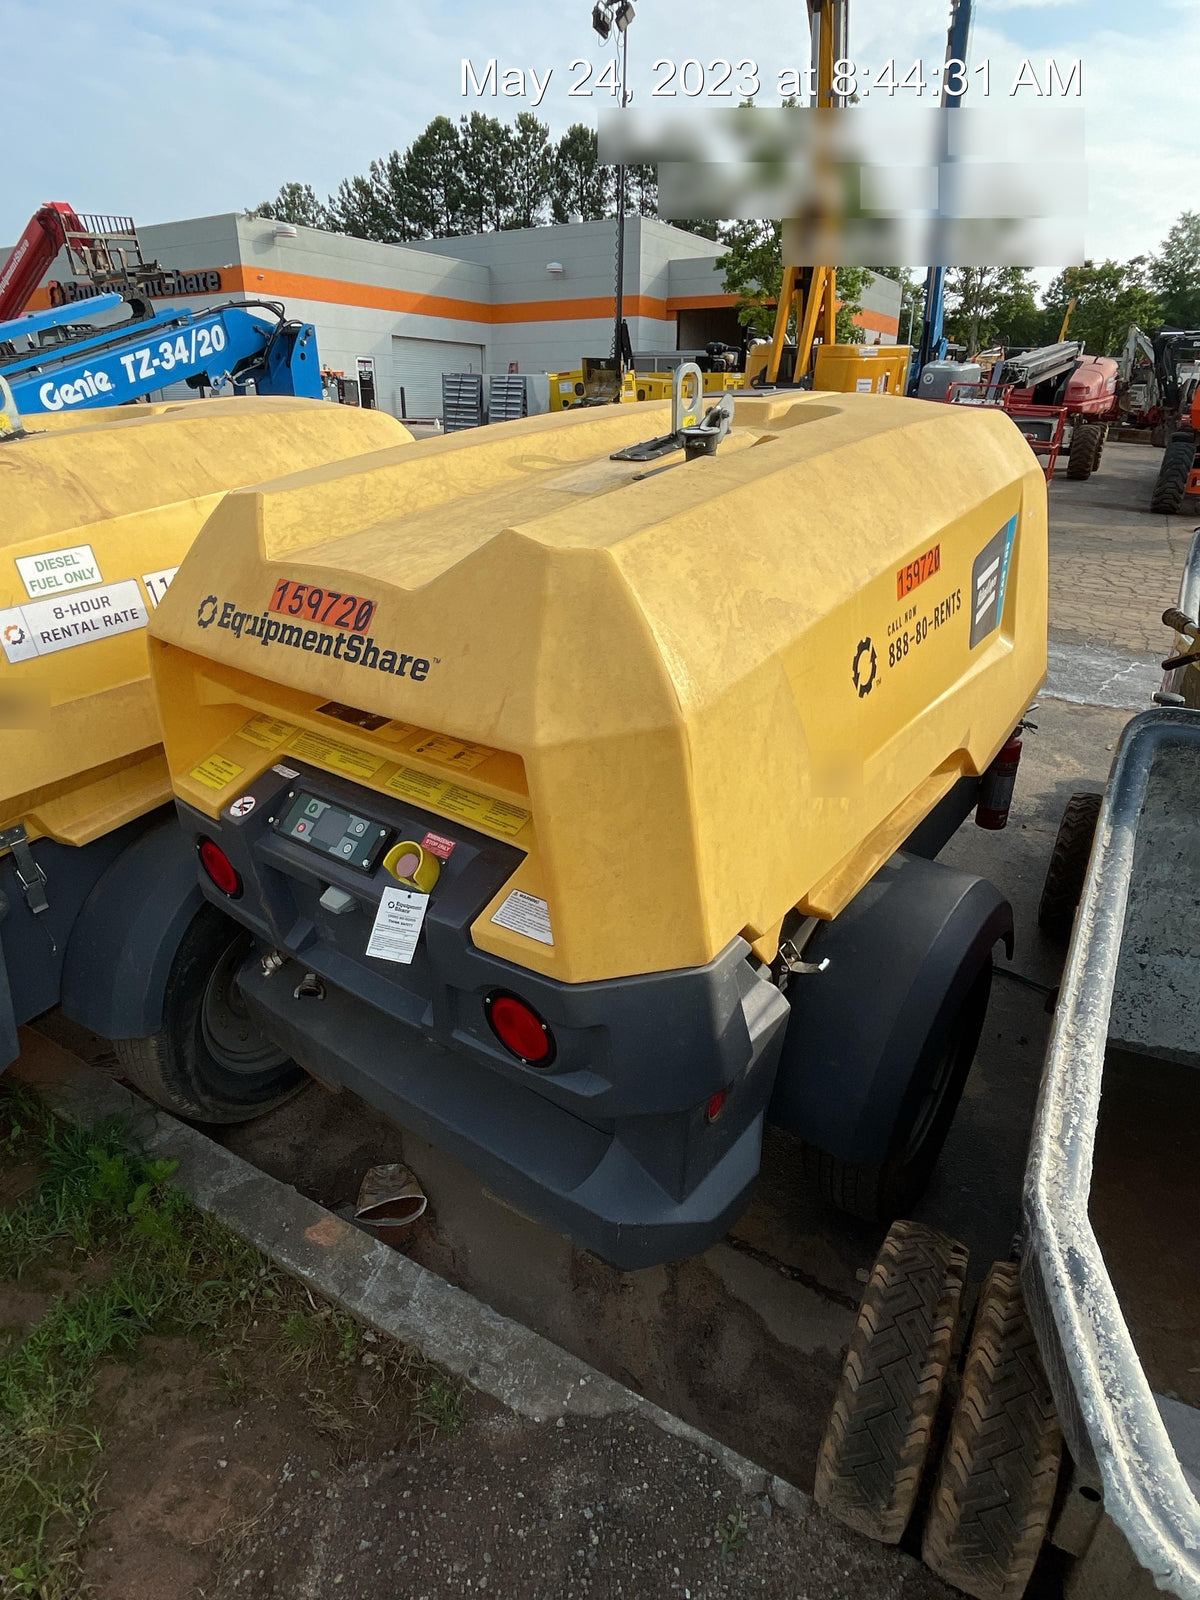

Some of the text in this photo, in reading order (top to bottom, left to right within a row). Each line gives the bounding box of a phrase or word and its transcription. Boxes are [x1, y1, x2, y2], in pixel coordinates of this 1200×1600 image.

[120, 324, 226, 384] TZ-34/20
[39, 369, 114, 411] Genie
[29, 567, 95, 592] FUEL ONLY
[34, 553, 80, 573] DIESEL
[898, 544, 940, 597] 159720
[53, 595, 111, 620] 8-HOUR
[276, 580, 376, 632] 159720
[887, 605, 917, 637] CALL NOW
[40, 608, 139, 644] RENTAL RATE
[217, 602, 430, 682] EquipmentShare
[888, 588, 962, 668] 888-80-RENTS
[425, 838, 438, 847] STOP
